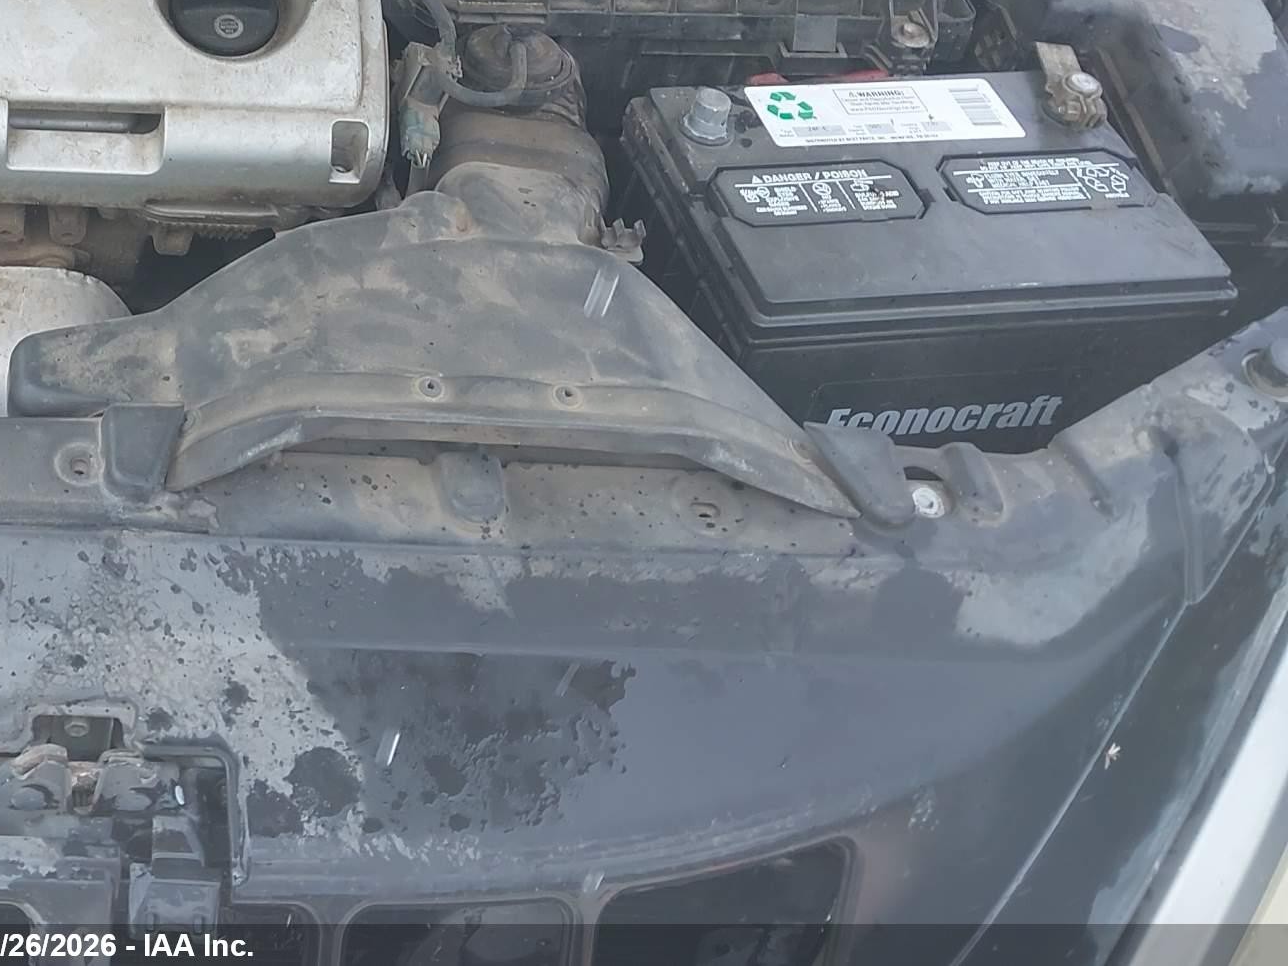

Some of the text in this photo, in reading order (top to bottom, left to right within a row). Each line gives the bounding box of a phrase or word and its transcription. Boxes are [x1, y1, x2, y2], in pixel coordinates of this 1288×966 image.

[762, 172, 812, 184] DANGER
[821, 169, 868, 180] POISON
[826, 395, 1063, 436] Econocraft
